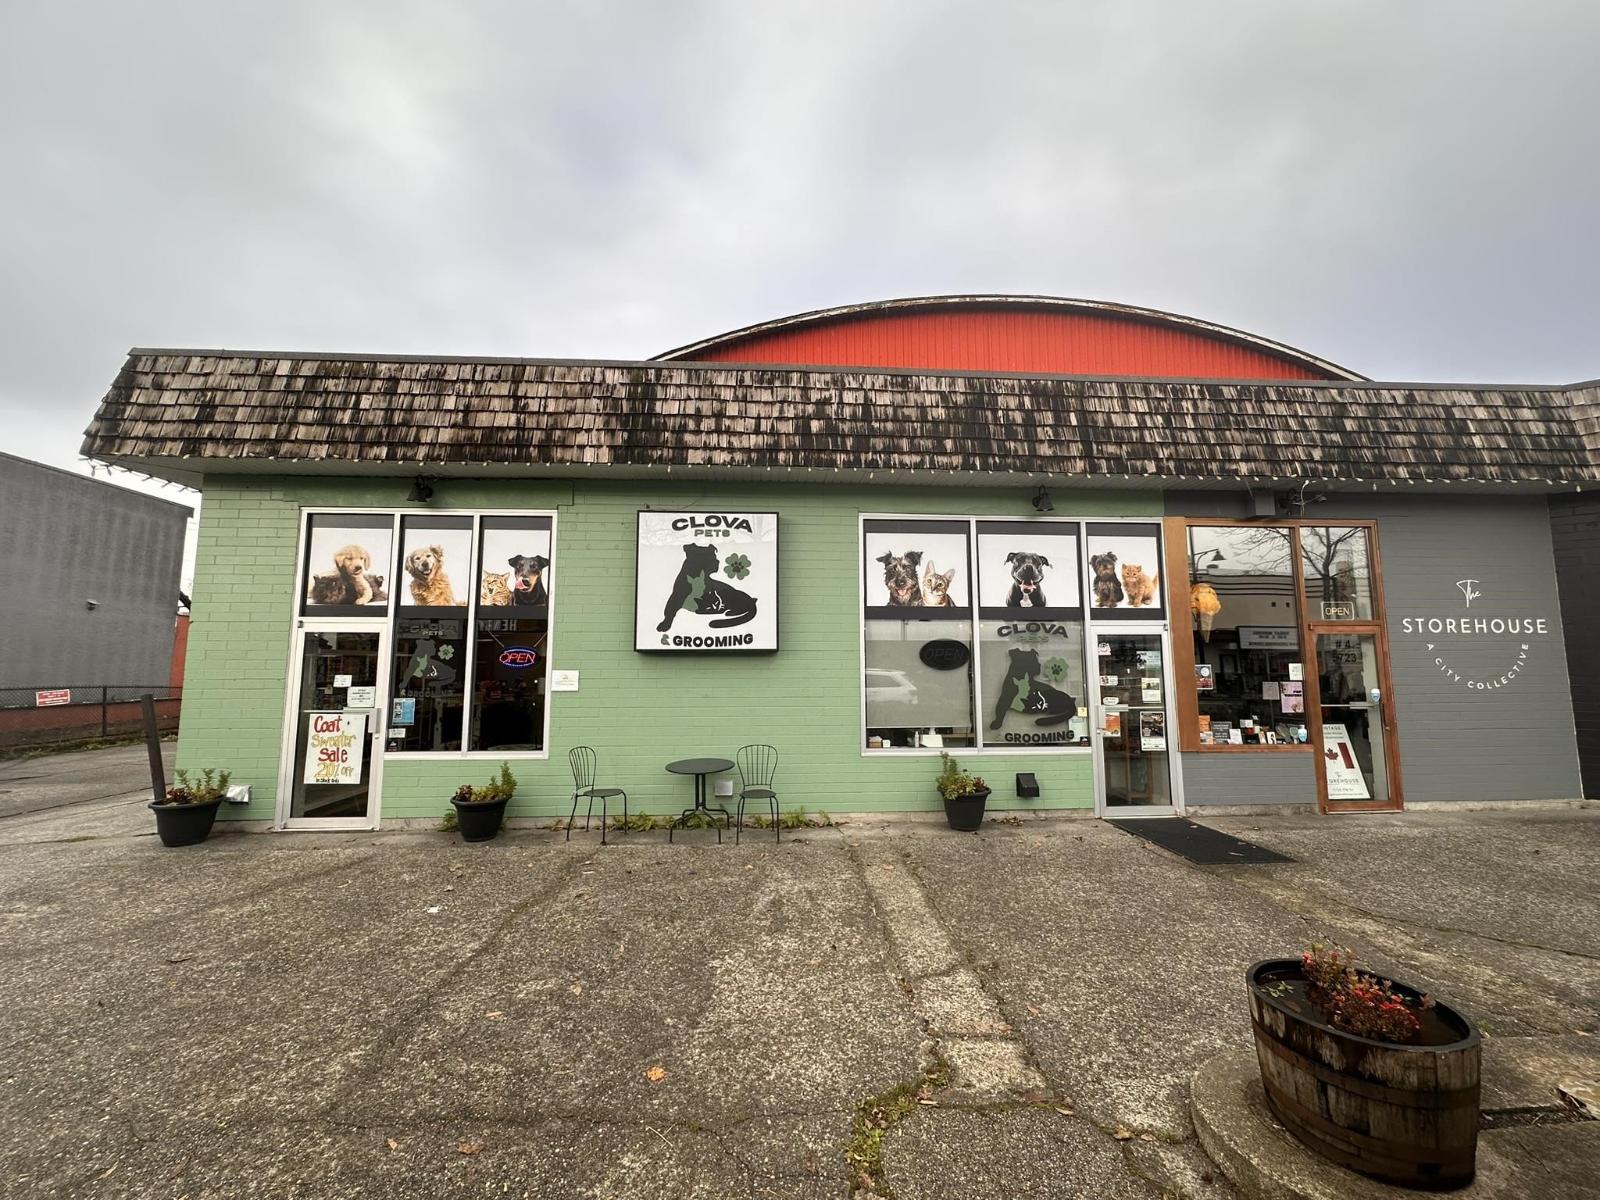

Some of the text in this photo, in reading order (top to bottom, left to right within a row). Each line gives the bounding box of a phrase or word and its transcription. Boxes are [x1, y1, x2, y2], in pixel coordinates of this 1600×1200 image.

[671, 515, 752, 533] CLOVA
[694, 529, 730, 537] PETS
[1456, 579, 1481, 608] The
[1325, 607, 1350, 616] OPEN
[997, 622, 1069, 638] CLOVA
[1402, 618, 1548, 633] STOREHOUSE
[660, 633, 753, 648] & GROOMING
[499, 652, 536, 664] OPEN
[1332, 652, 1357, 663] 5723
[1426, 643, 1529, 689] A CITY COLLECTIVE
[314, 715, 342, 733] Coat
[311, 730, 357, 748] Sweater
[1005, 730, 1075, 743] GROOMING
[318, 747, 348, 763] Sale
